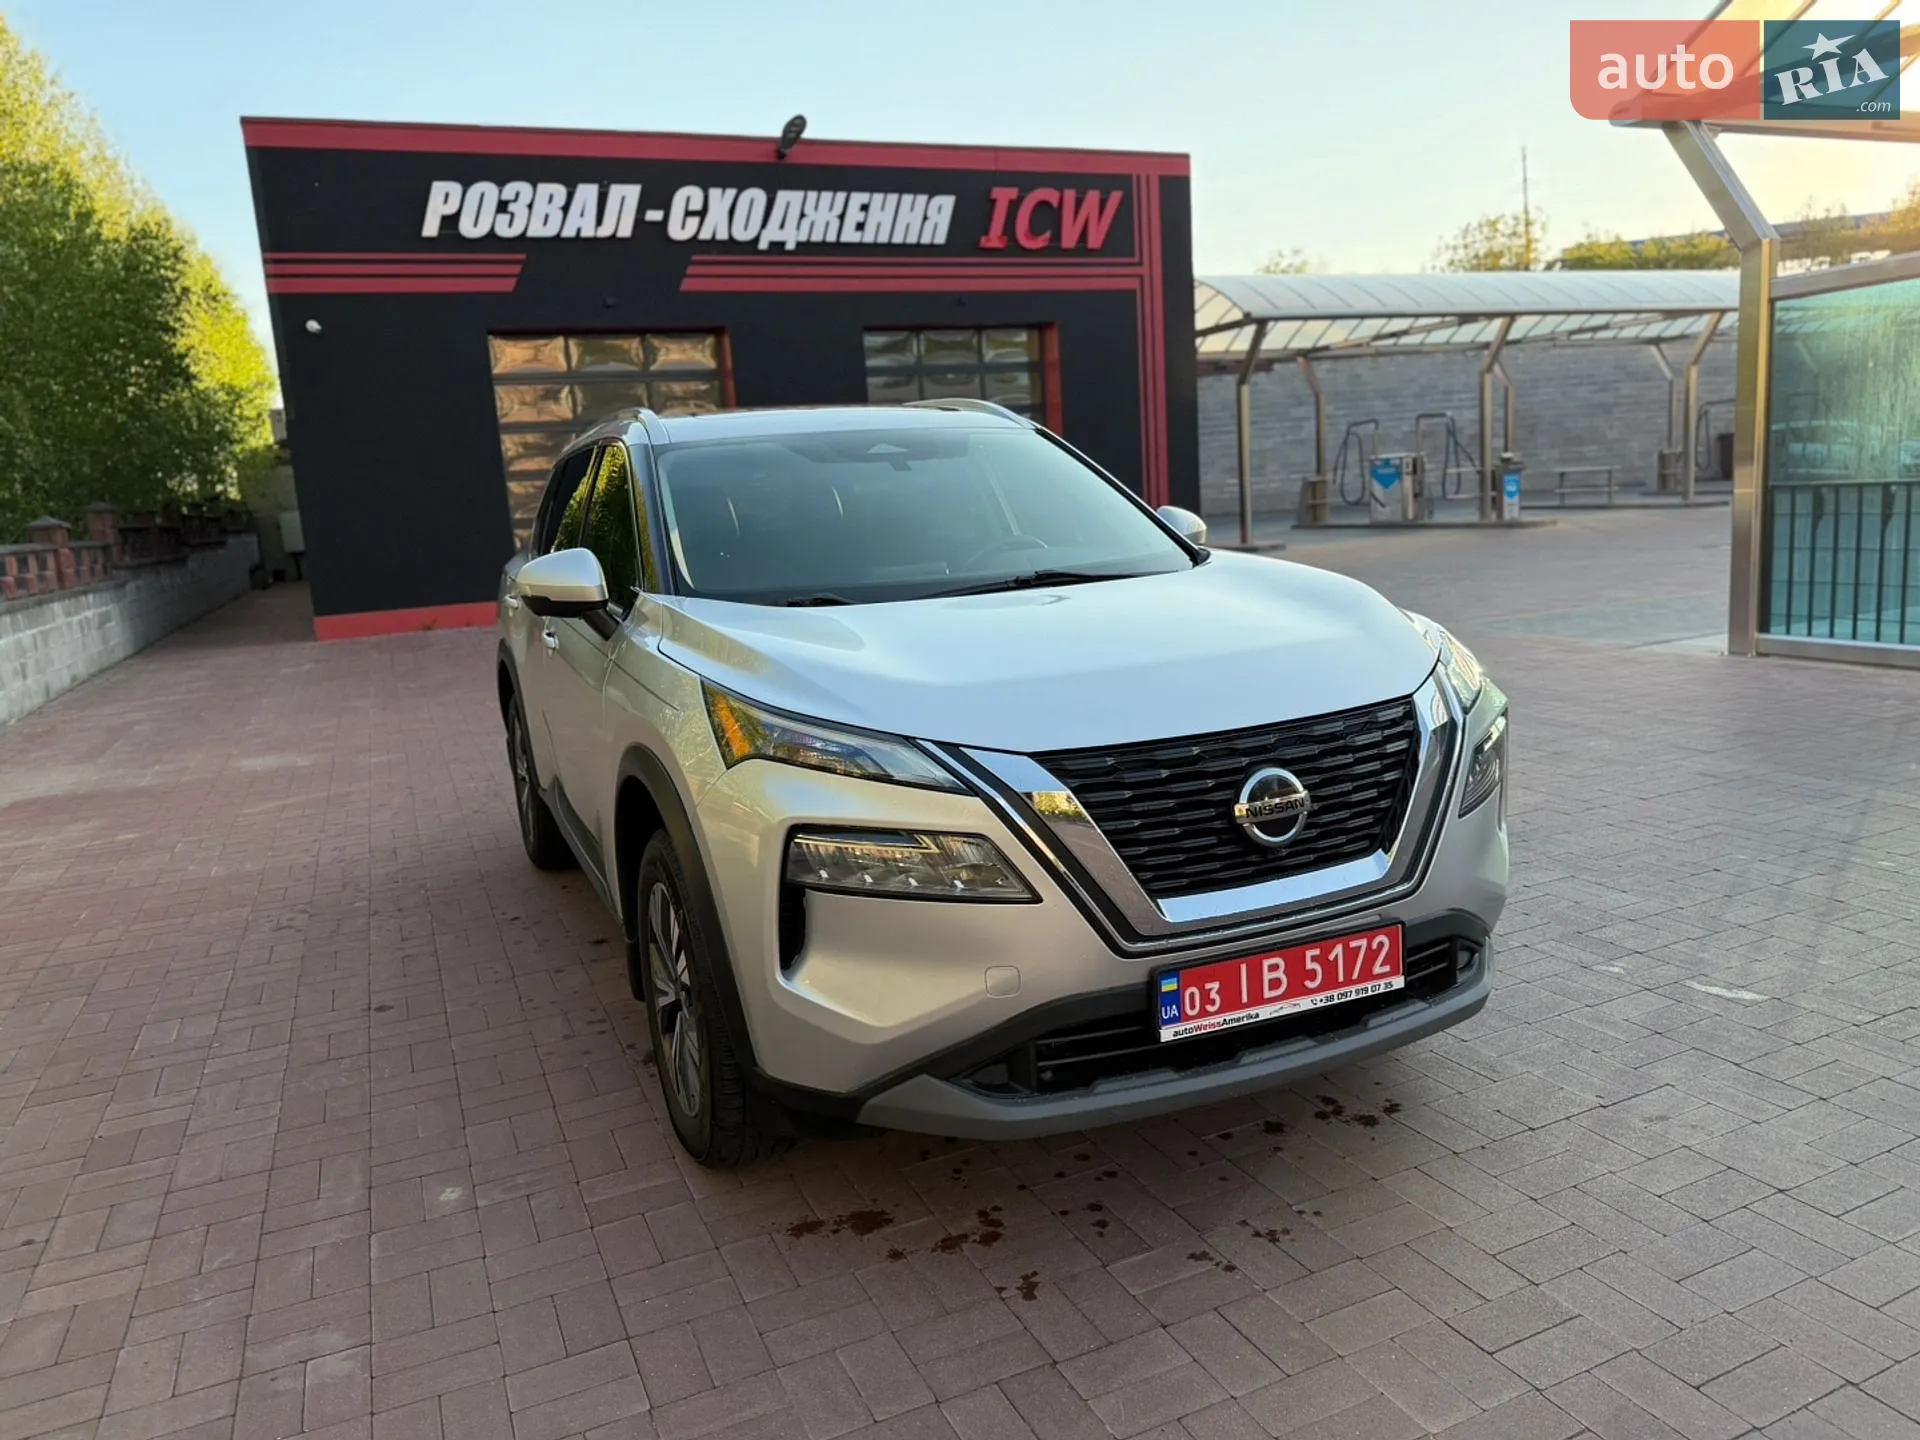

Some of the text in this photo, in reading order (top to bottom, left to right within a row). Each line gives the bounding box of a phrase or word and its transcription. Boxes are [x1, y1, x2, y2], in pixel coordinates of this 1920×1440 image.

[979, 186, 1124, 250] ICW
[1245, 797, 1305, 819] NISSAN
[1183, 980, 1221, 1017] 03
[1303, 934, 1391, 989] 5172
[1337, 990, 1353, 1000] 097
[1354, 986, 1369, 997] 919
[1370, 984, 1381, 993] 07
[1161, 1004, 1179, 1020] UA
